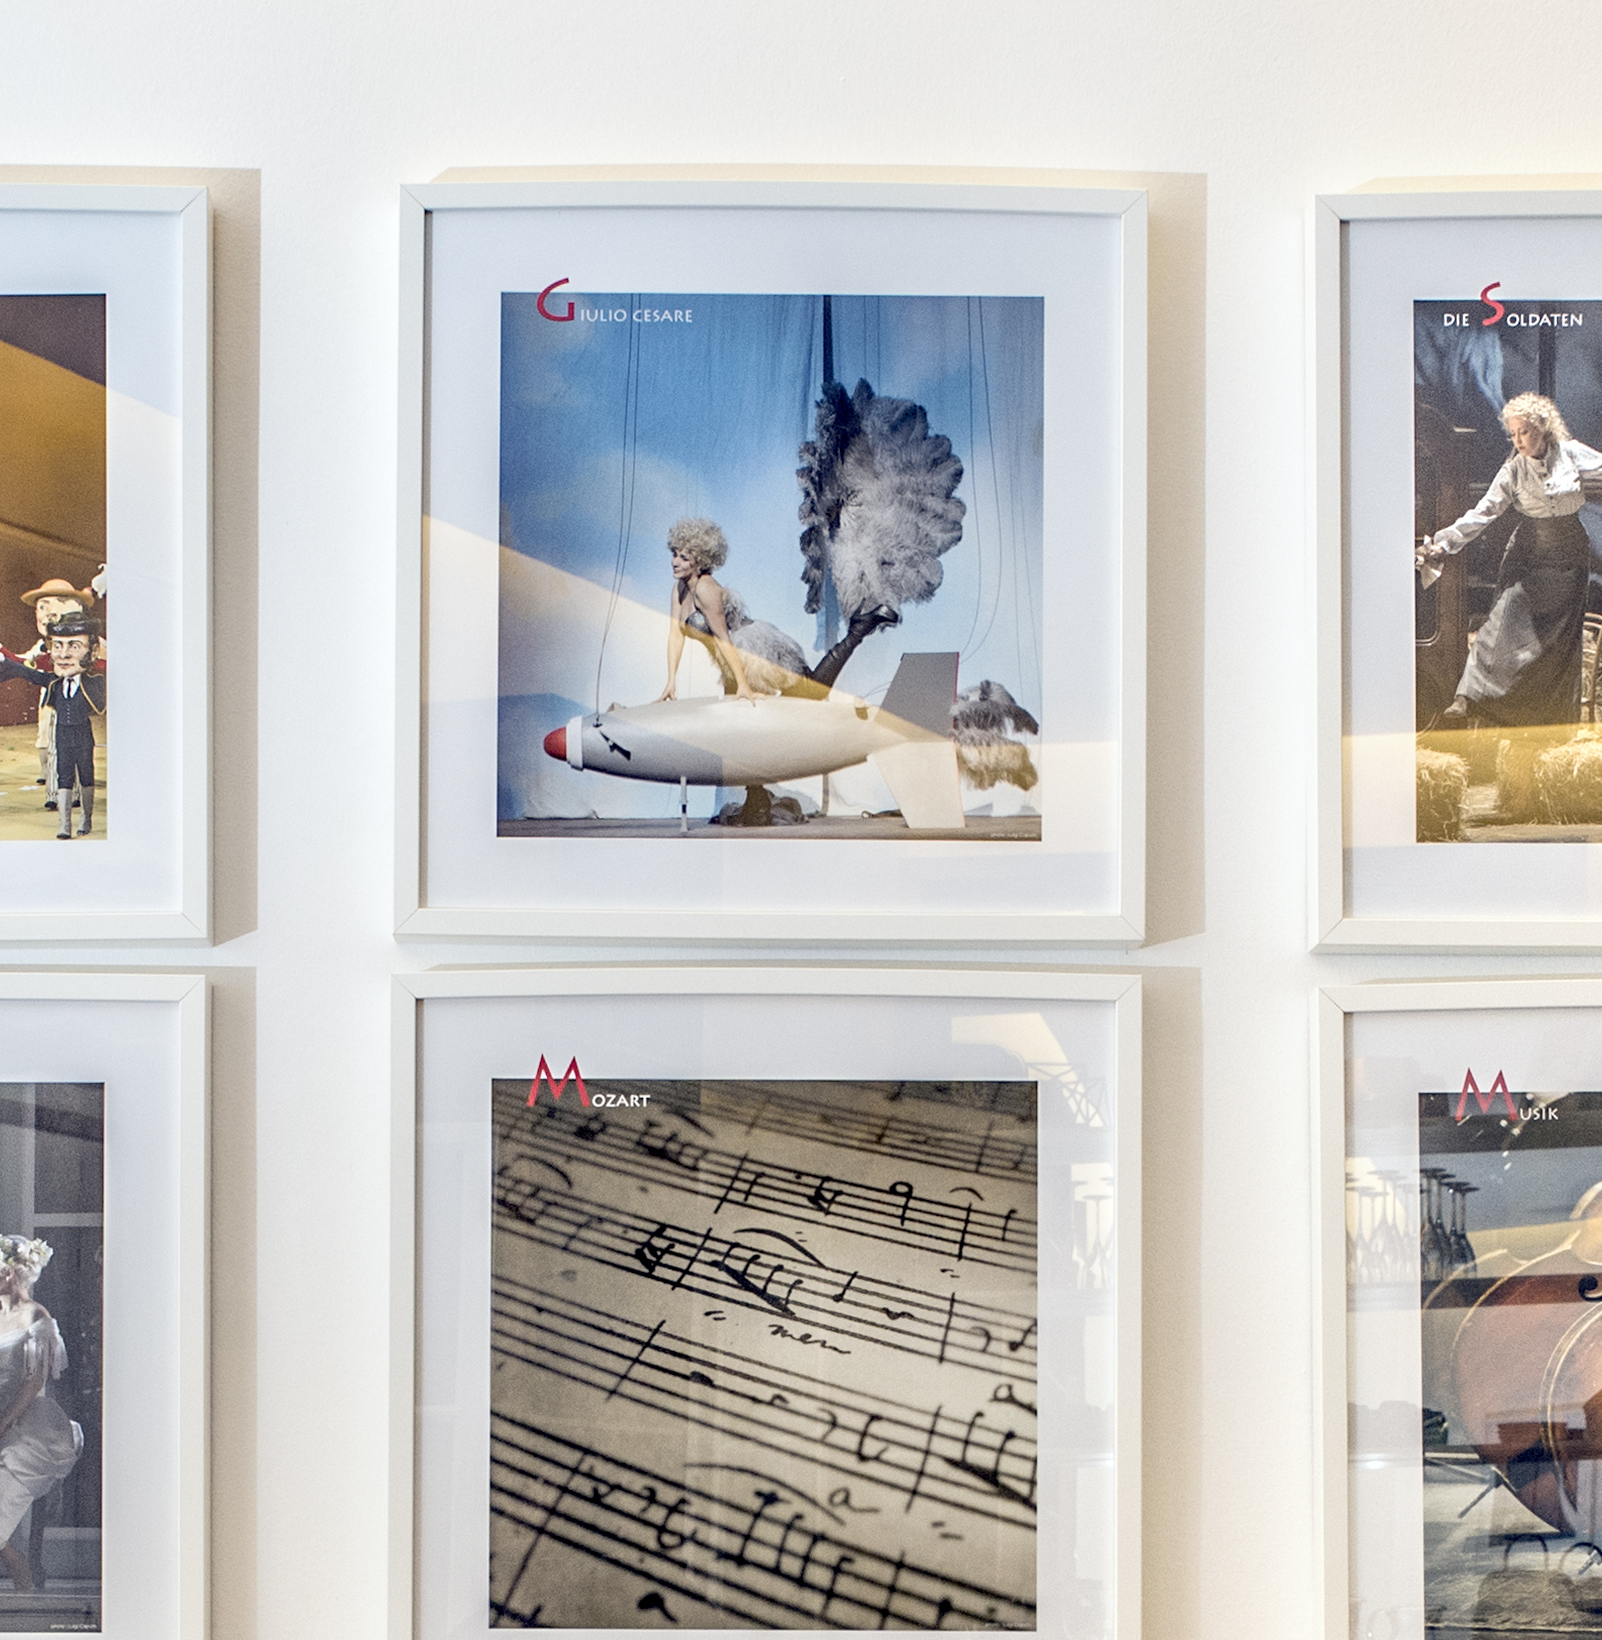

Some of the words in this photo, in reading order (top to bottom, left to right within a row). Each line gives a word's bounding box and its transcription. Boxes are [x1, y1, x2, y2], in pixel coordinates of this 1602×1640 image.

[536, 277, 627, 323] GIULIO
[632, 309, 693, 323] CESARE
[1443, 313, 1470, 327] DIE
[1480, 281, 1583, 328] SOLDATEN
[526, 1053, 651, 1108] MOZART
[1454, 1067, 1559, 1122] MUSIK
